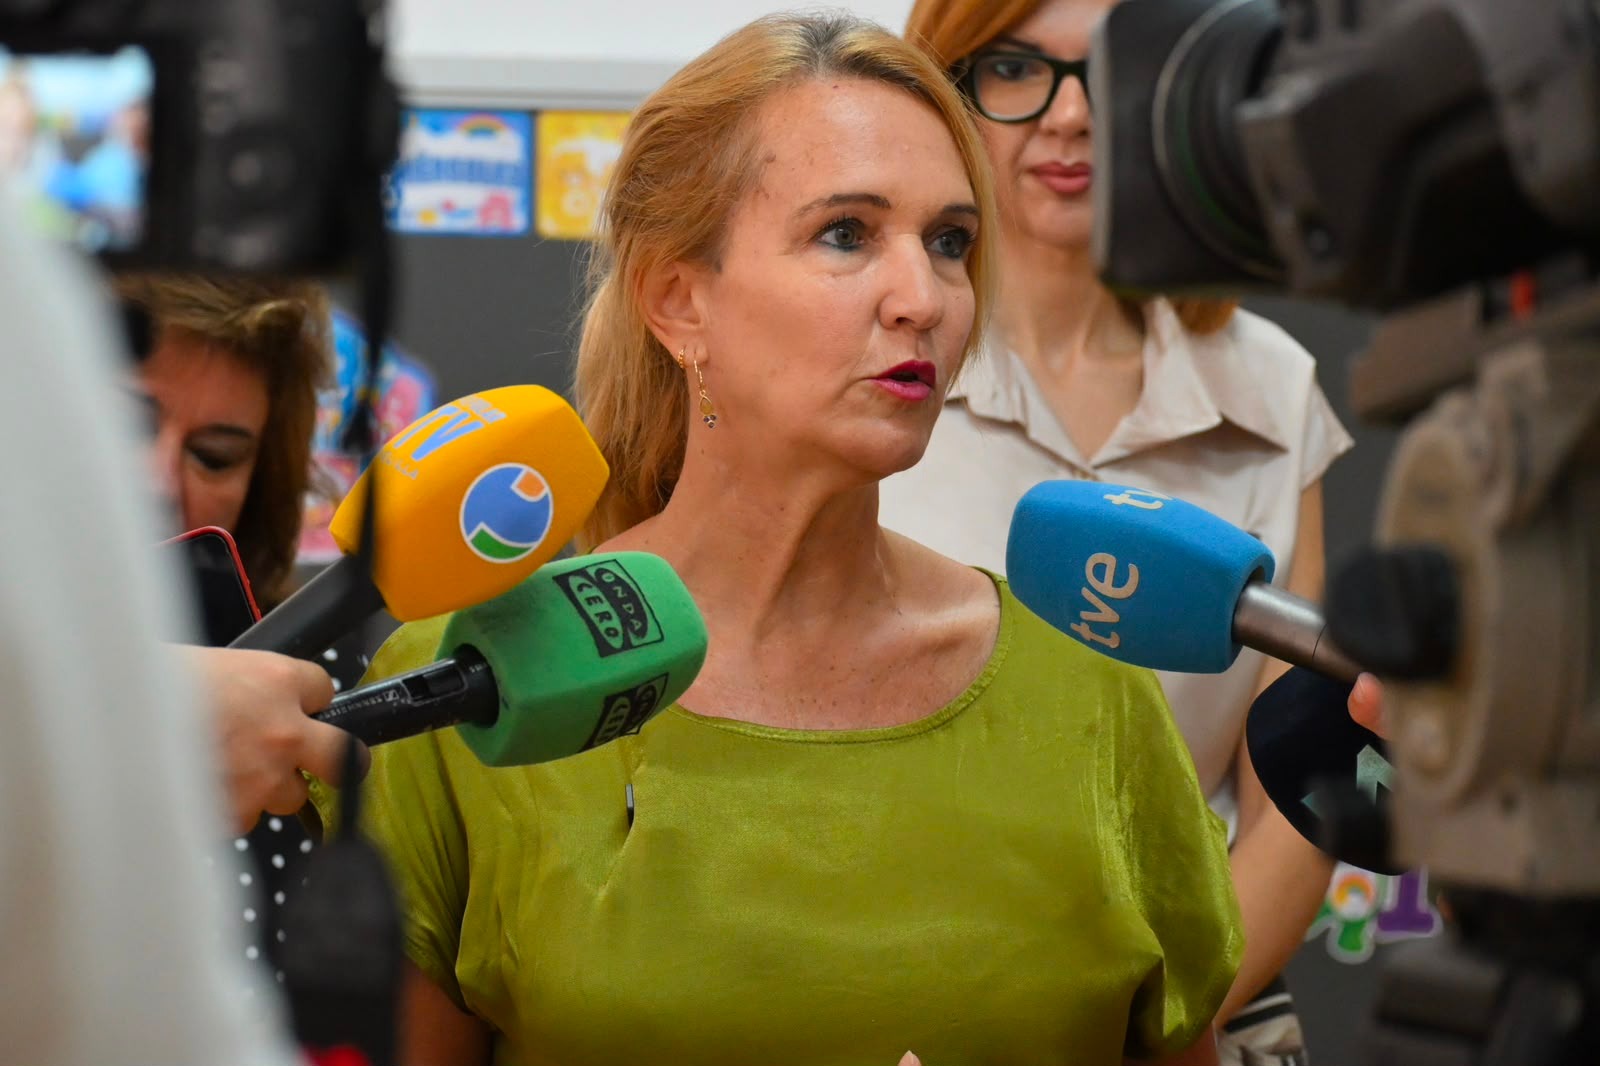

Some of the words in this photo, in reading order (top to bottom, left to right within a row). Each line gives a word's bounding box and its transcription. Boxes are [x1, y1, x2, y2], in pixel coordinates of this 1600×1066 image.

[393, 405, 485, 461] TV
[576, 582, 620, 638] CERO
[601, 572, 644, 631] ONDA
[1069, 552, 1140, 649] tve
